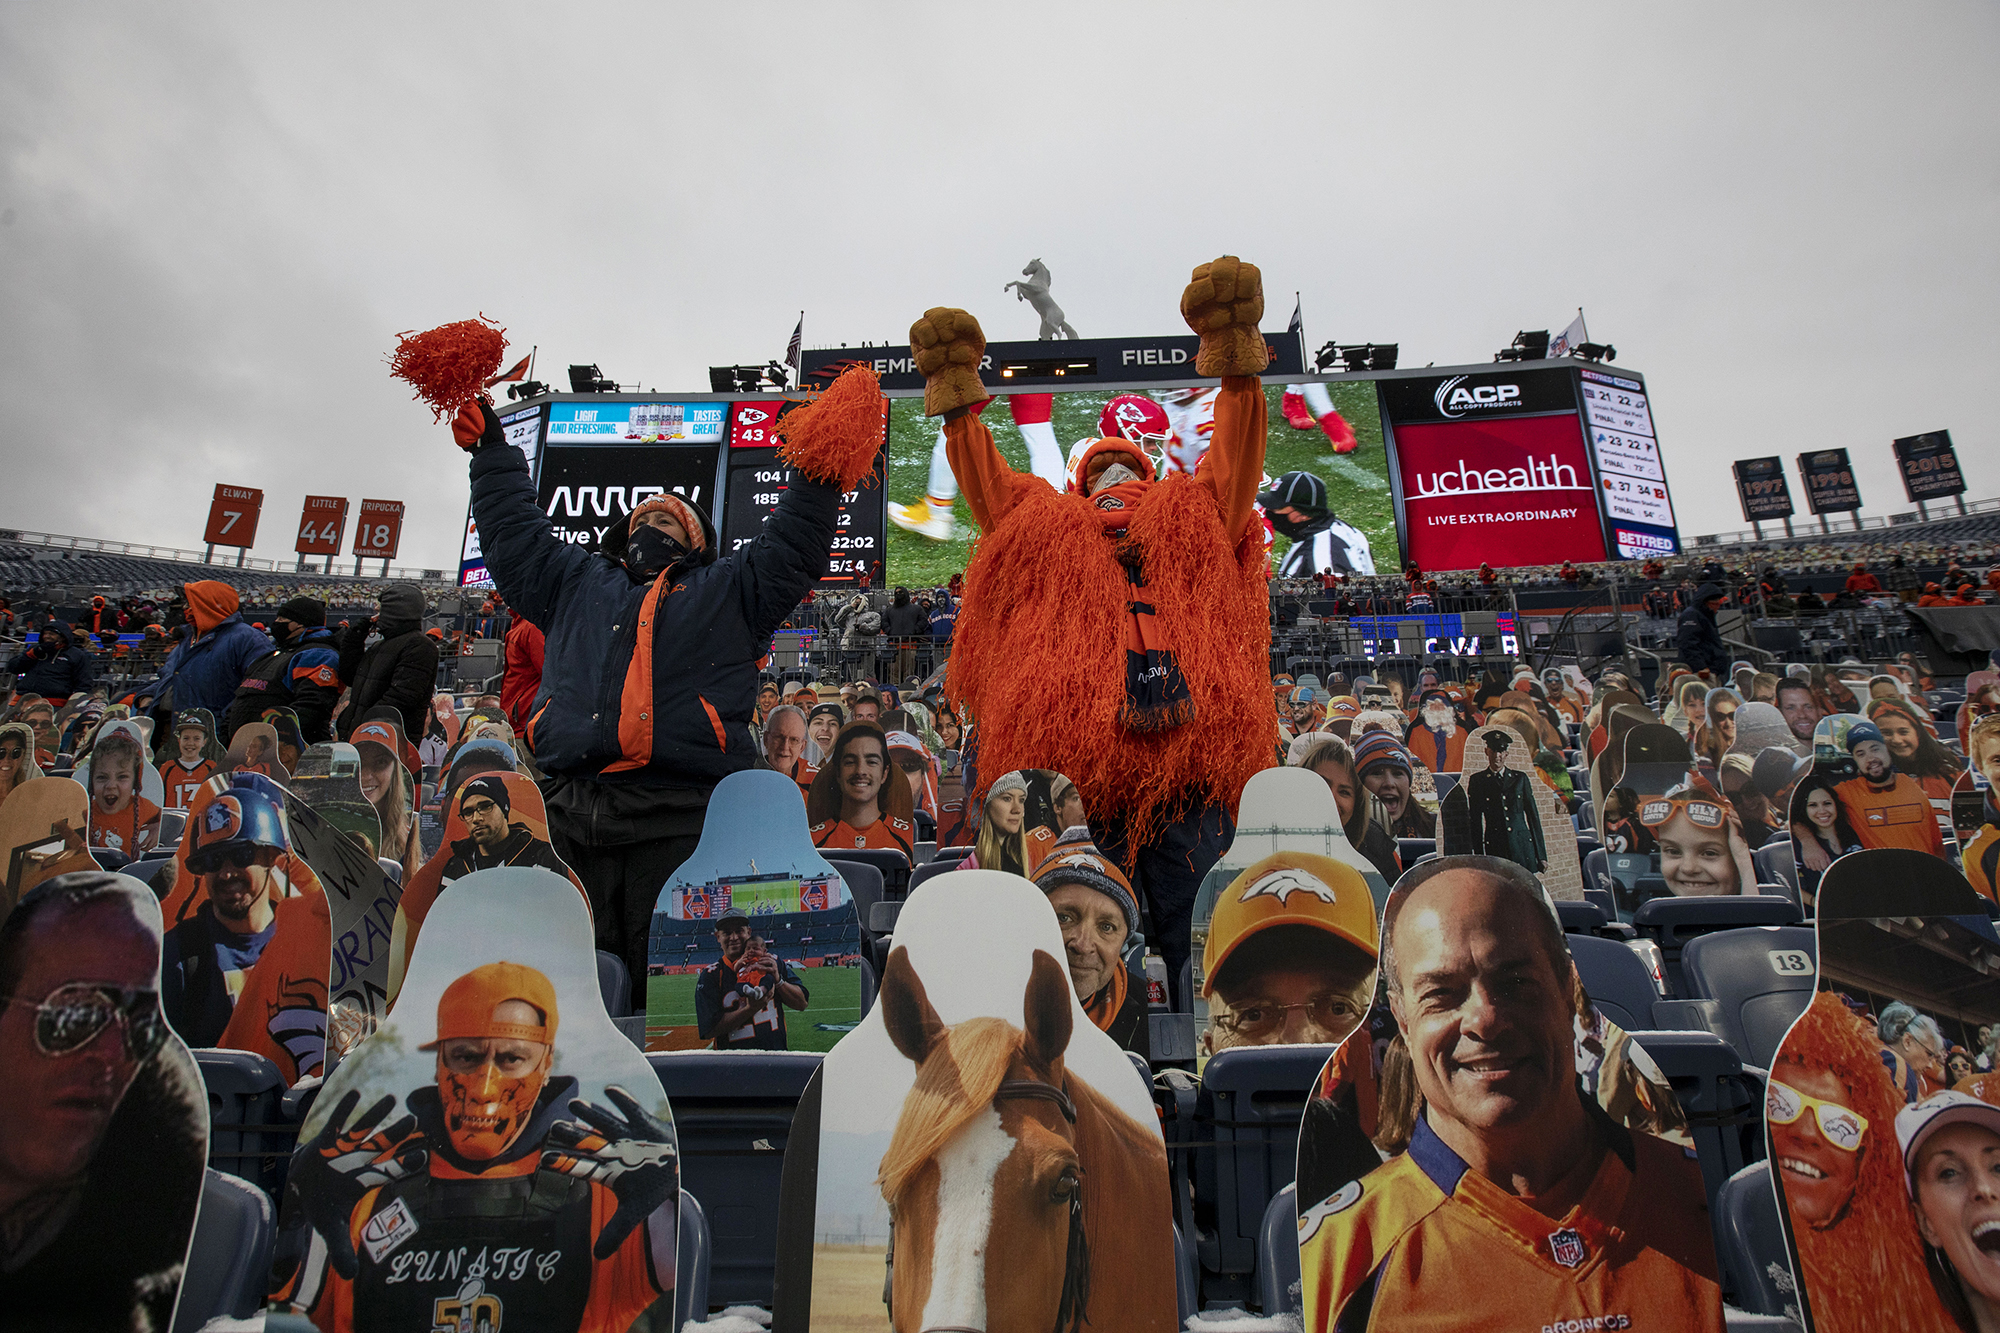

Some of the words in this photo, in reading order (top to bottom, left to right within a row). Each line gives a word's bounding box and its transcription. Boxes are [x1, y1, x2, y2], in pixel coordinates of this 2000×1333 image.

[1122, 349, 1188, 366] FIELD
[1449, 384, 1520, 405] ACP
[1599, 391, 1611, 401] 21
[1618, 395, 1631, 406] 22
[1484, 400, 1522, 408] PRODUCTS
[574, 410, 598, 421] LIGHT
[693, 410, 722, 421] TASTES
[1595, 413, 1615, 423] FINAL
[513, 427, 525, 439] 22
[551, 423, 567, 434] AND
[568, 423, 618, 434] REFRESHING.
[692, 423, 719, 434] GREAT.
[741, 429, 764, 442] 43
[1608, 435, 1622, 446] 23
[1627, 439, 1641, 450] 22
[1604, 459, 1625, 469] FINAL
[1905, 454, 1955, 475] 2015
[754, 471, 781, 482] 104
[1416, 453, 1578, 496] uchealth
[1809, 471, 1853, 488] 1998
[1619, 481, 1630, 492] 37
[1637, 484, 1651, 496] 34
[1744, 478, 1783, 495] 1997
[222, 488, 253, 500] ELWAY
[753, 493, 779, 505] 185
[311, 499, 338, 509] LITTLE
[362, 502, 401, 512] TRIPUCKA
[1614, 505, 1635, 516] FINAL
[219, 511, 243, 535] 7
[1428, 515, 1457, 526] LIVE
[1459, 508, 1577, 524] EXTRAORDINARY
[300, 520, 337, 545] 44
[361, 523, 390, 548] 18
[551, 526, 590, 544] Five
[830, 537, 874, 549] 32:02
[1618, 531, 1673, 550] BETFRED
[300, 564, 315, 572] 229
[829, 560, 865, 573] 5/34
[425, 571, 440, 579] 230
[1644, 803, 1669, 814] HIG
[1689, 803, 1719, 817] HLY
[1776, 955, 1806, 971] 13
[386, 1246, 561, 1284] LUNATIC
[1542, 1315, 1629, 1333] BRONCOS
